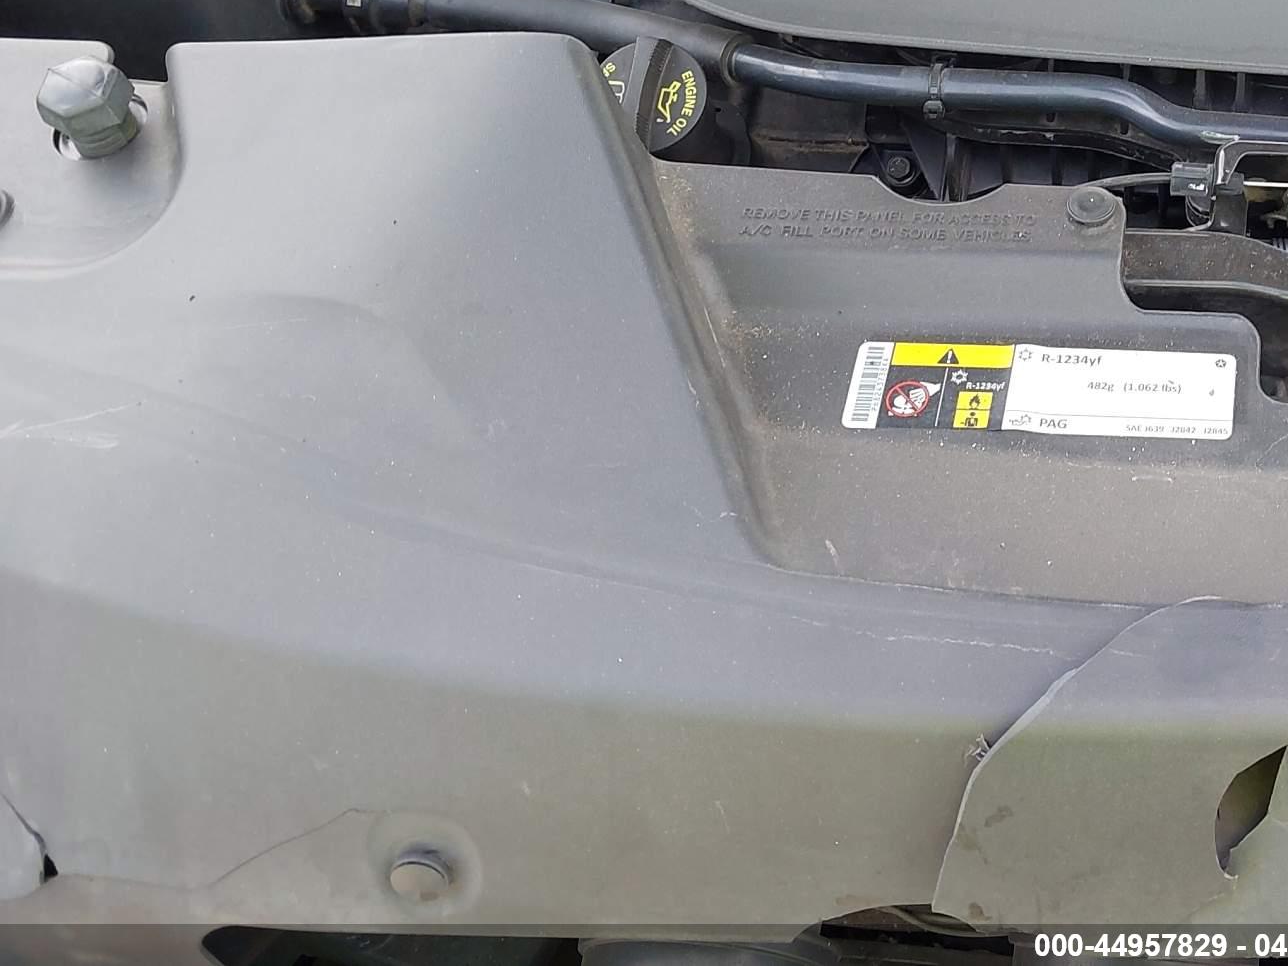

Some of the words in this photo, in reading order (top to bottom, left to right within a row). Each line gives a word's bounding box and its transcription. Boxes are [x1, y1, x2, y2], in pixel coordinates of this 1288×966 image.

[681, 70, 698, 118] ENGINE
[666, 117, 688, 136] OIL
[742, 208, 811, 221] REMOVE
[815, 209, 853, 222] THIS
[856, 210, 905, 224] PANEL
[912, 212, 945, 225] FOR
[1015, 214, 1037, 227] TO
[739, 224, 773, 236] A/C
[781, 225, 814, 238] FILL
[820, 226, 865, 238] PORT
[870, 227, 894, 239] ON
[899, 228, 947, 241] SOME
[953, 229, 1033, 243] VEHICLES
[1041, 353, 1103, 367] R-1234yf
[1087, 381, 1115, 393] 482g
[1123, 382, 1158, 393] (1.062
[1039, 417, 1068, 430] PAG
